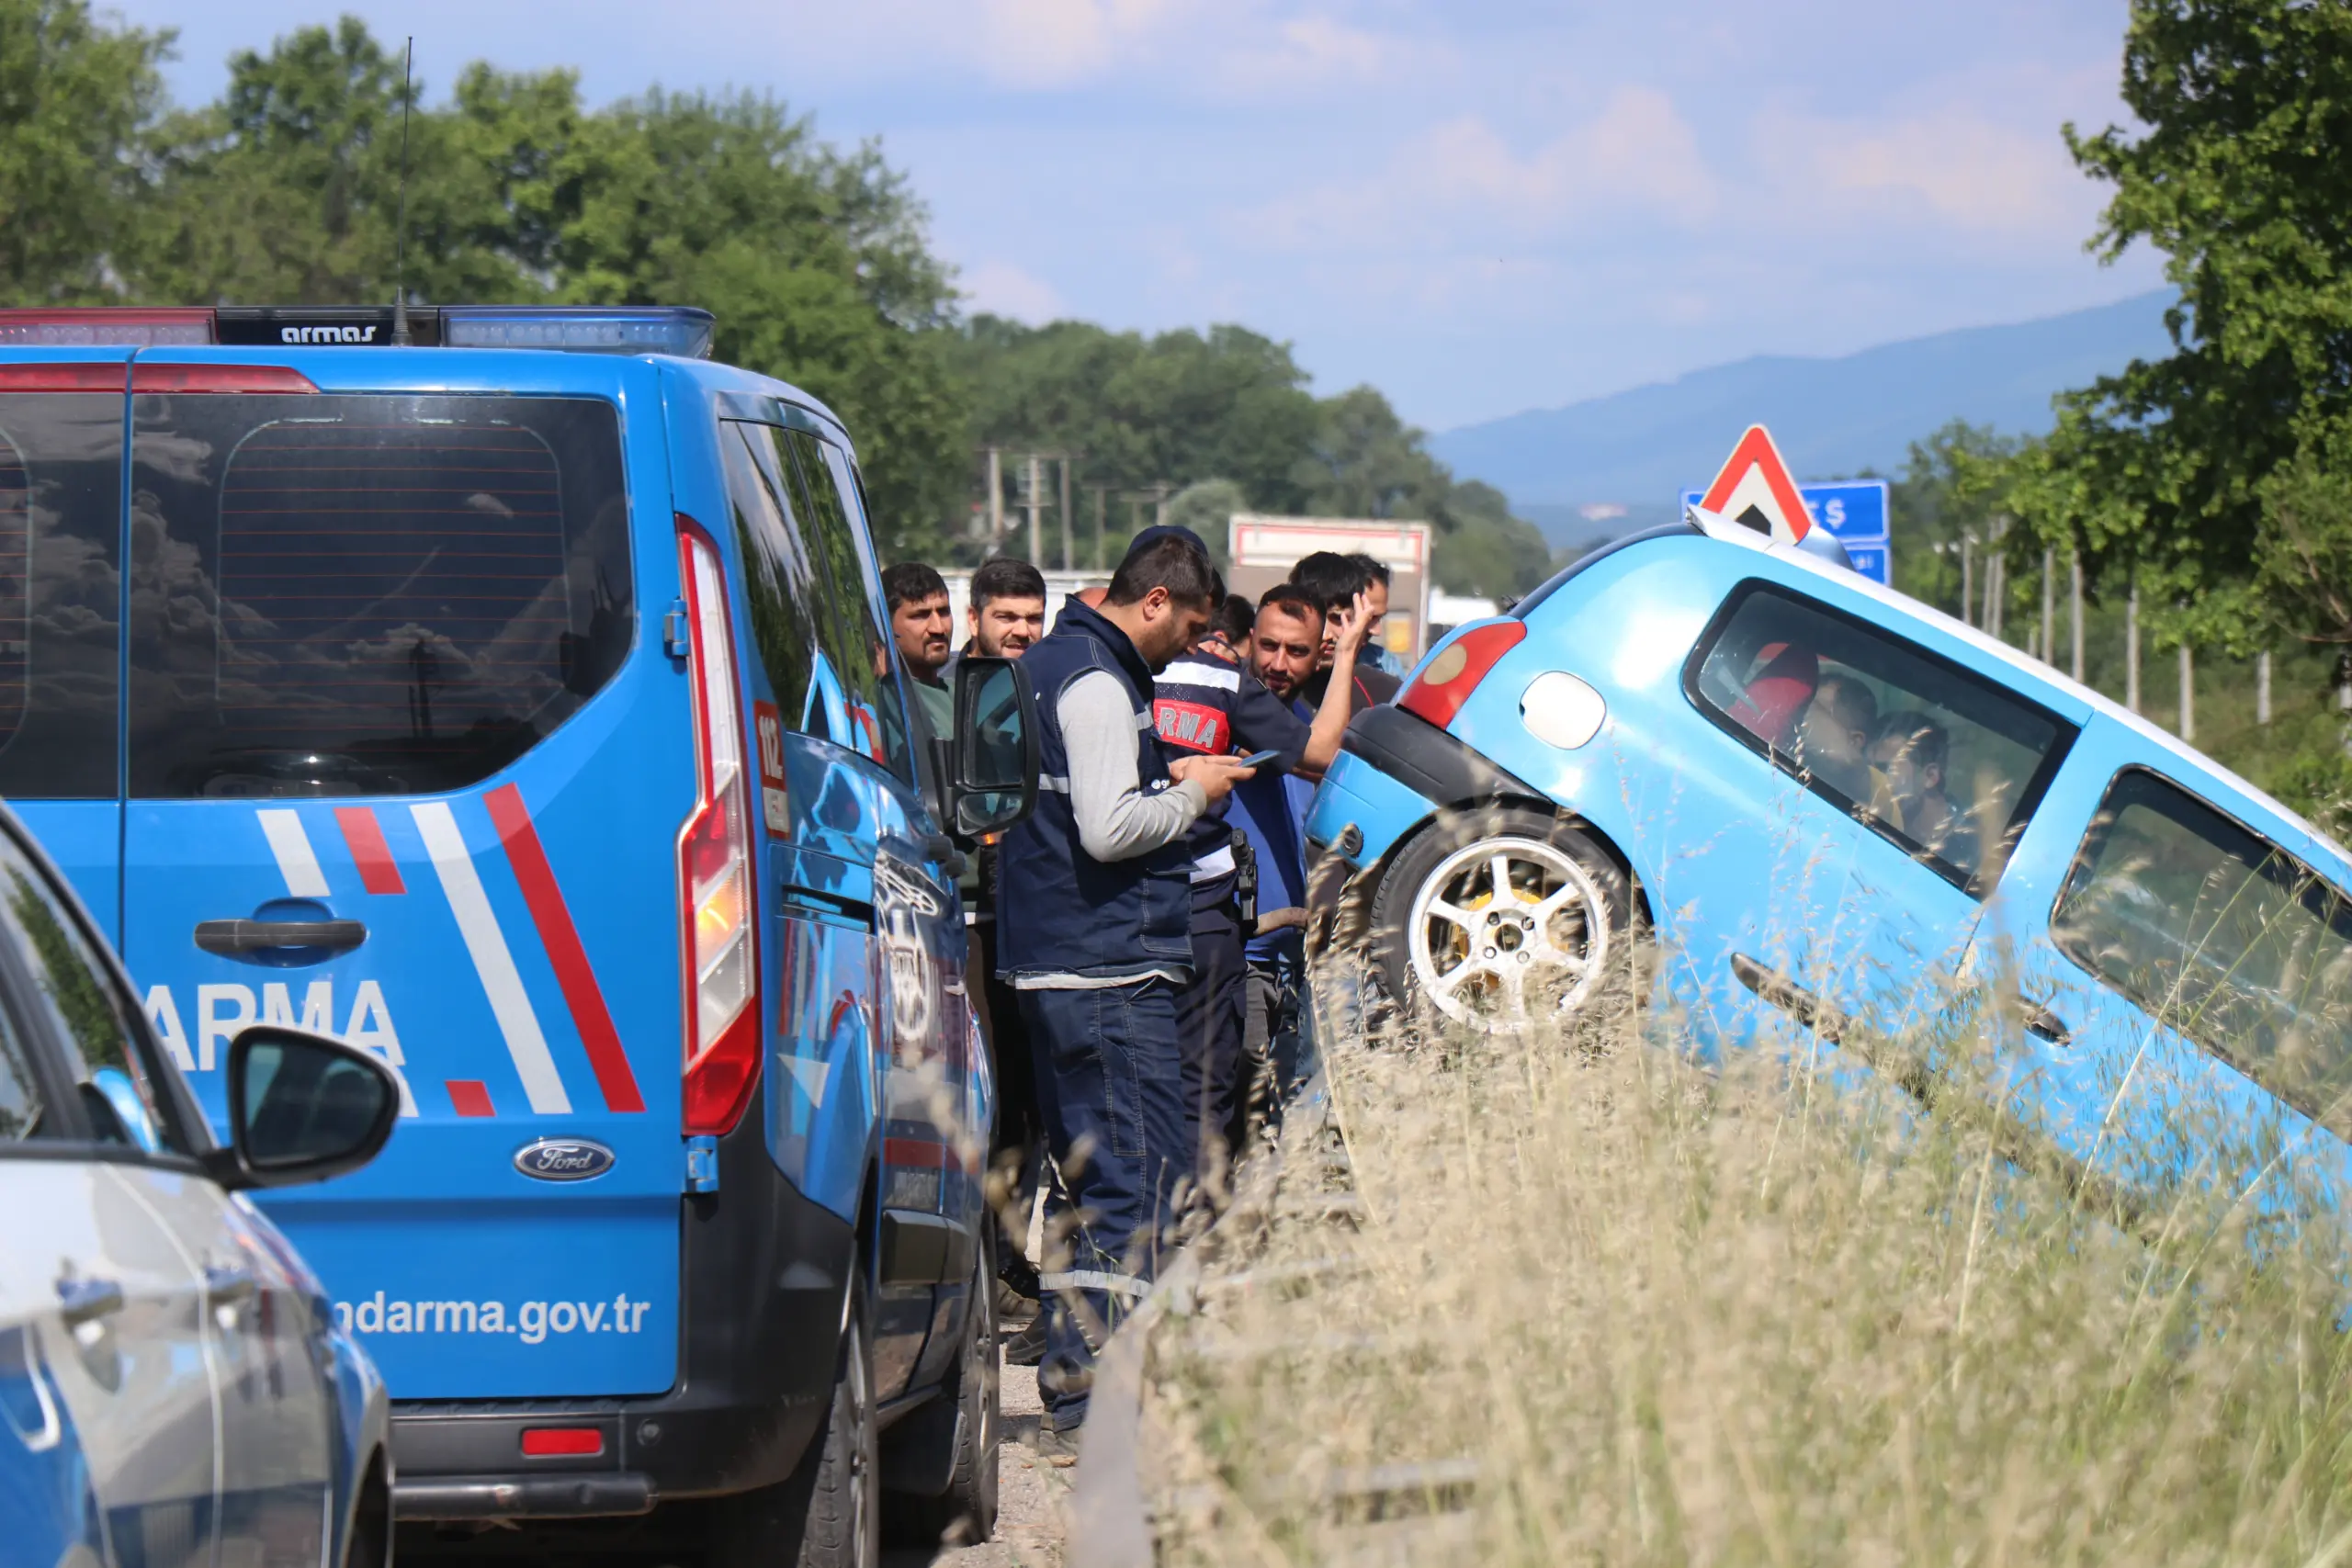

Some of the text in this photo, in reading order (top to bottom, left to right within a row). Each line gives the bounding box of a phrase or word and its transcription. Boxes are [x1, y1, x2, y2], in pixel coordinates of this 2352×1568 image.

[281, 326, 376, 343] armas
[1159, 707, 1216, 748] RMA
[537, 1147, 593, 1169] Ford
